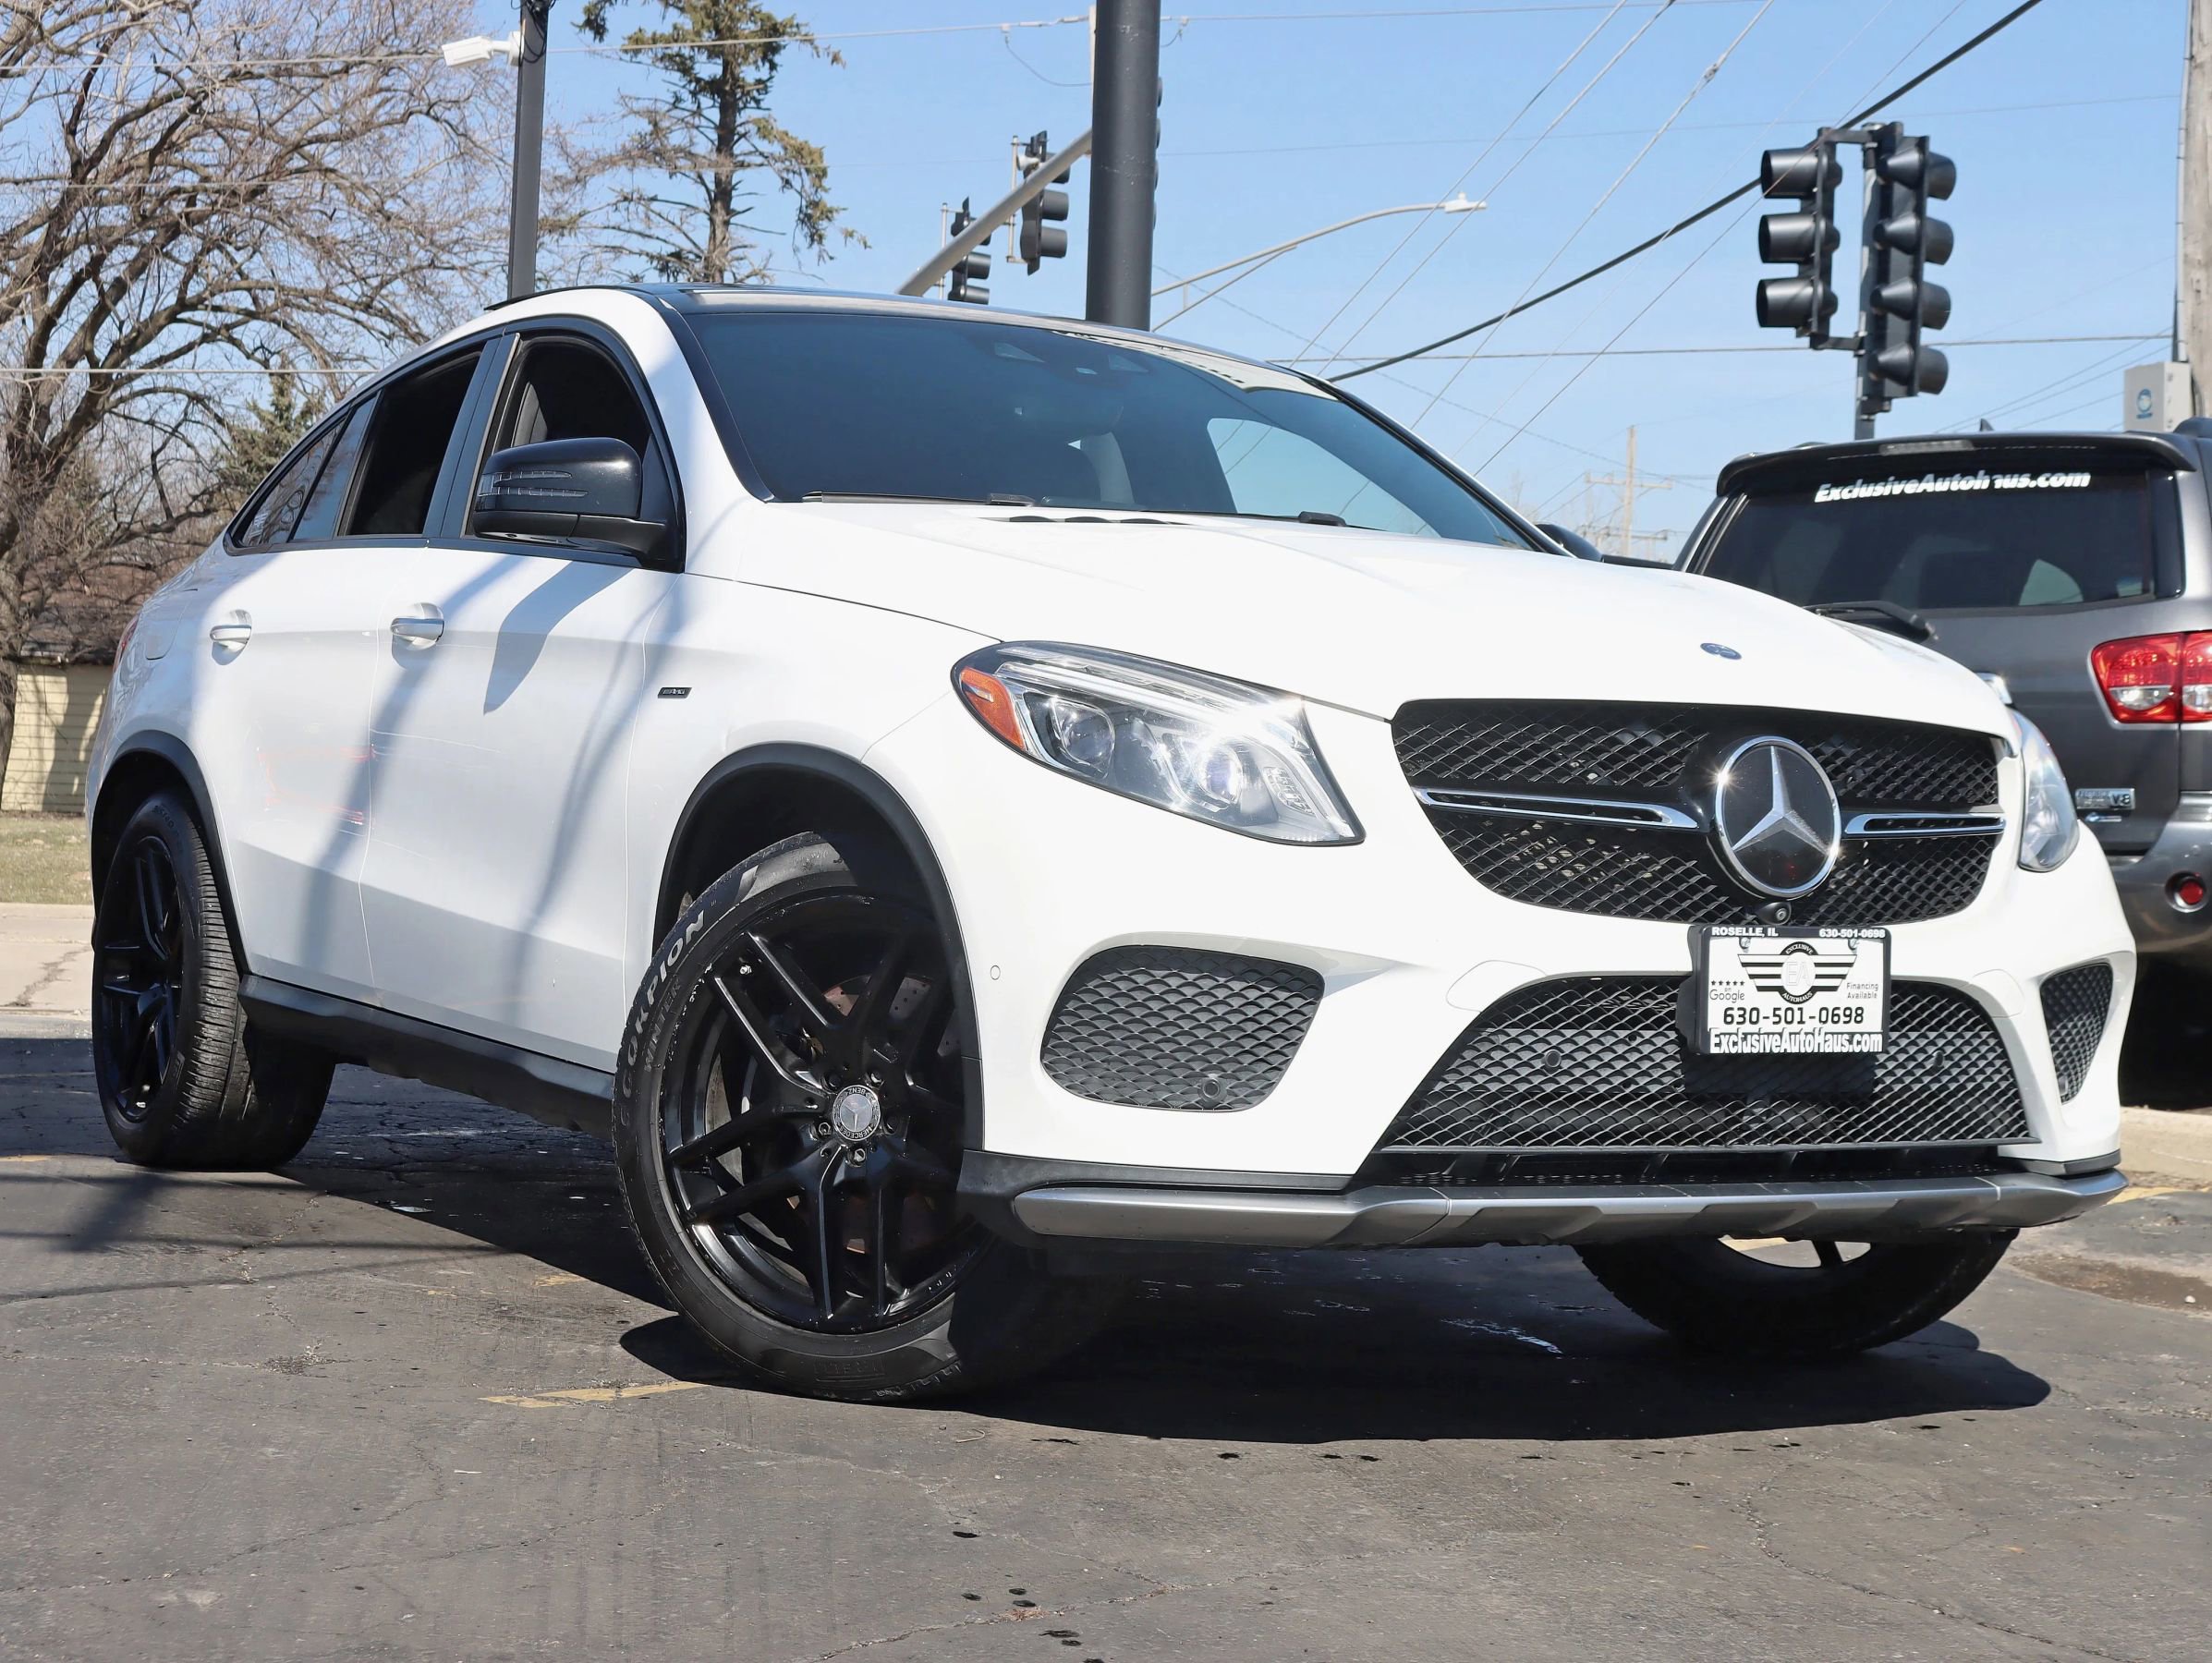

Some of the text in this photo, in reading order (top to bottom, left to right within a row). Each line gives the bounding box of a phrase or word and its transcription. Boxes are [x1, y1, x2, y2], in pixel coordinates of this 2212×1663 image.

[1711, 927, 1779, 938] ROSELLE, IL
[1818, 928, 1886, 939] 630-501-0698
[1785, 943, 1814, 955] EXCLUSIVE
[1846, 982, 1879, 992] Financing
[1709, 989, 1745, 1003] Google
[1781, 991, 1813, 1003] AUTOHAUS
[1847, 991, 1878, 1000] Available
[1723, 1006, 1865, 1026] 630-501-0698
[847, 1086, 867, 1095] BENZ
[839, 1125, 873, 1139] MERCEDES
